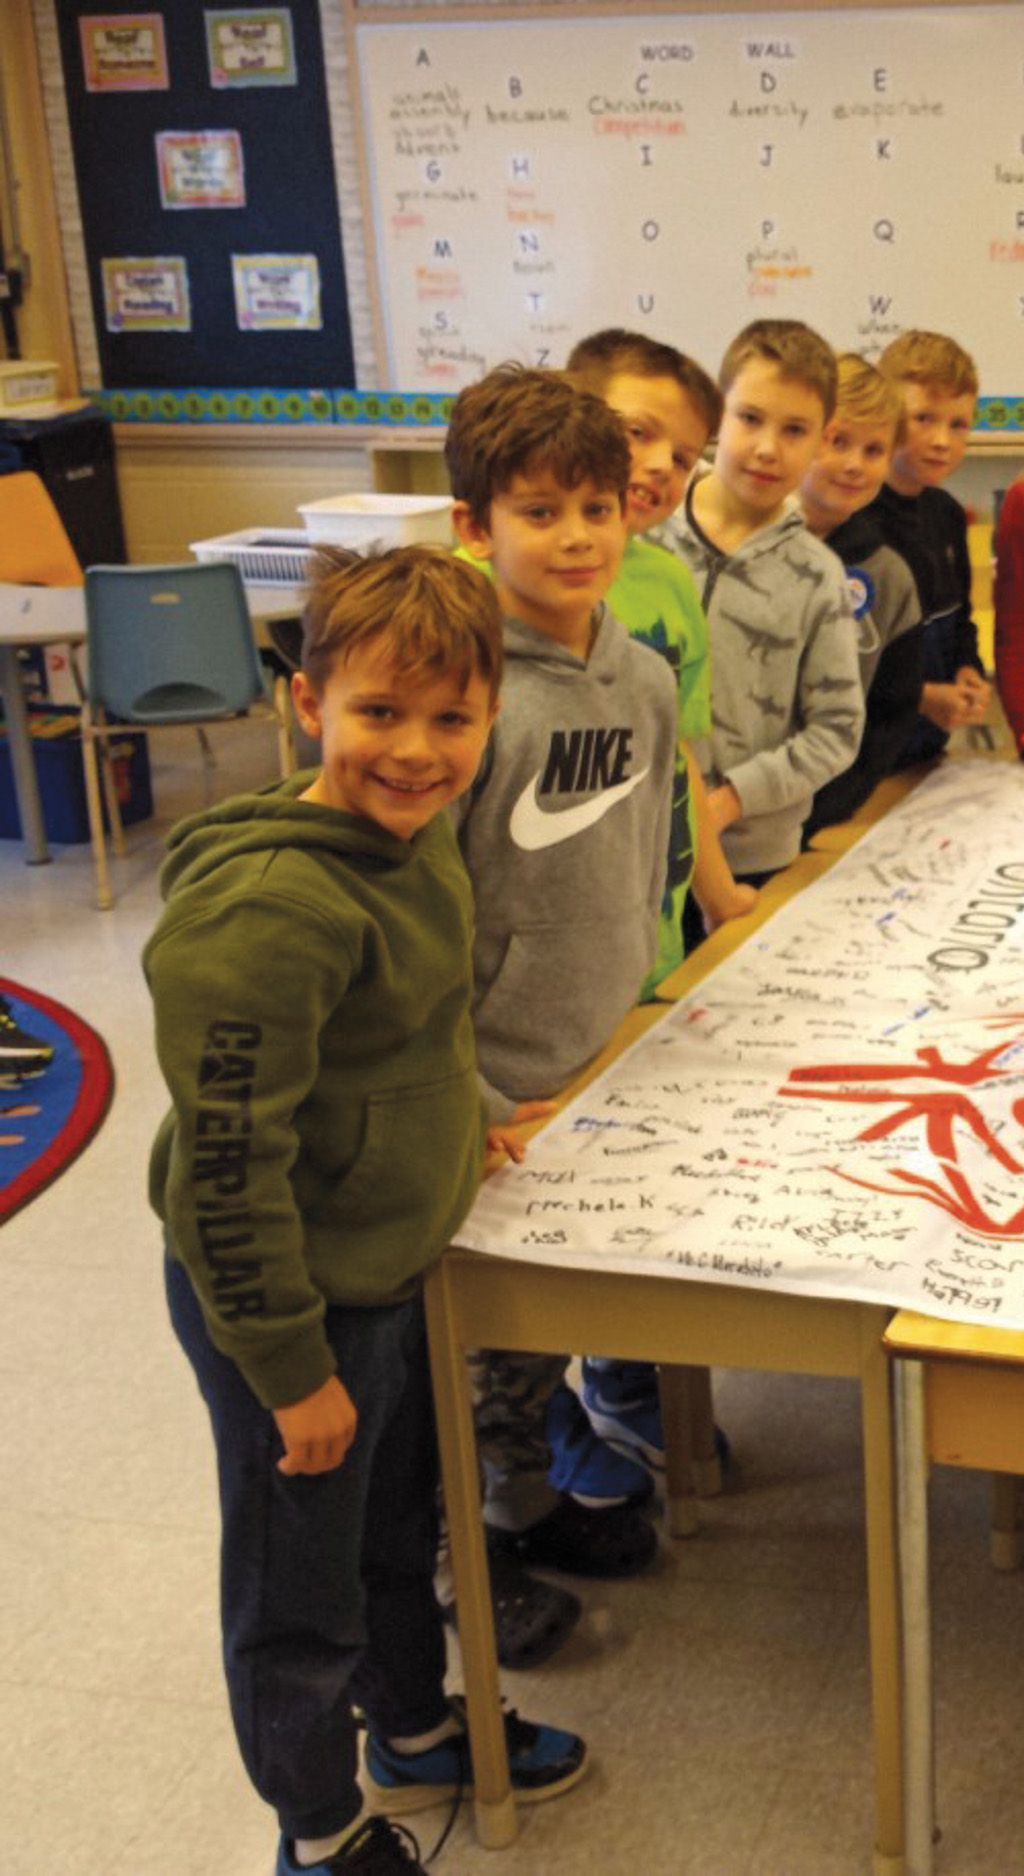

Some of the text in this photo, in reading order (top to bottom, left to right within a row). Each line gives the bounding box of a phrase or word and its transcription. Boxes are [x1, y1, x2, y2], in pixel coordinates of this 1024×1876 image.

[641, 46, 693, 61] WORD
[747, 43, 795, 59] WALL
[486, 106, 571, 123] because
[832, 98, 944, 126] evaporate
[540, 728, 633, 795] NIKE
[192, 1020, 264, 1323] CATERPILLAR
